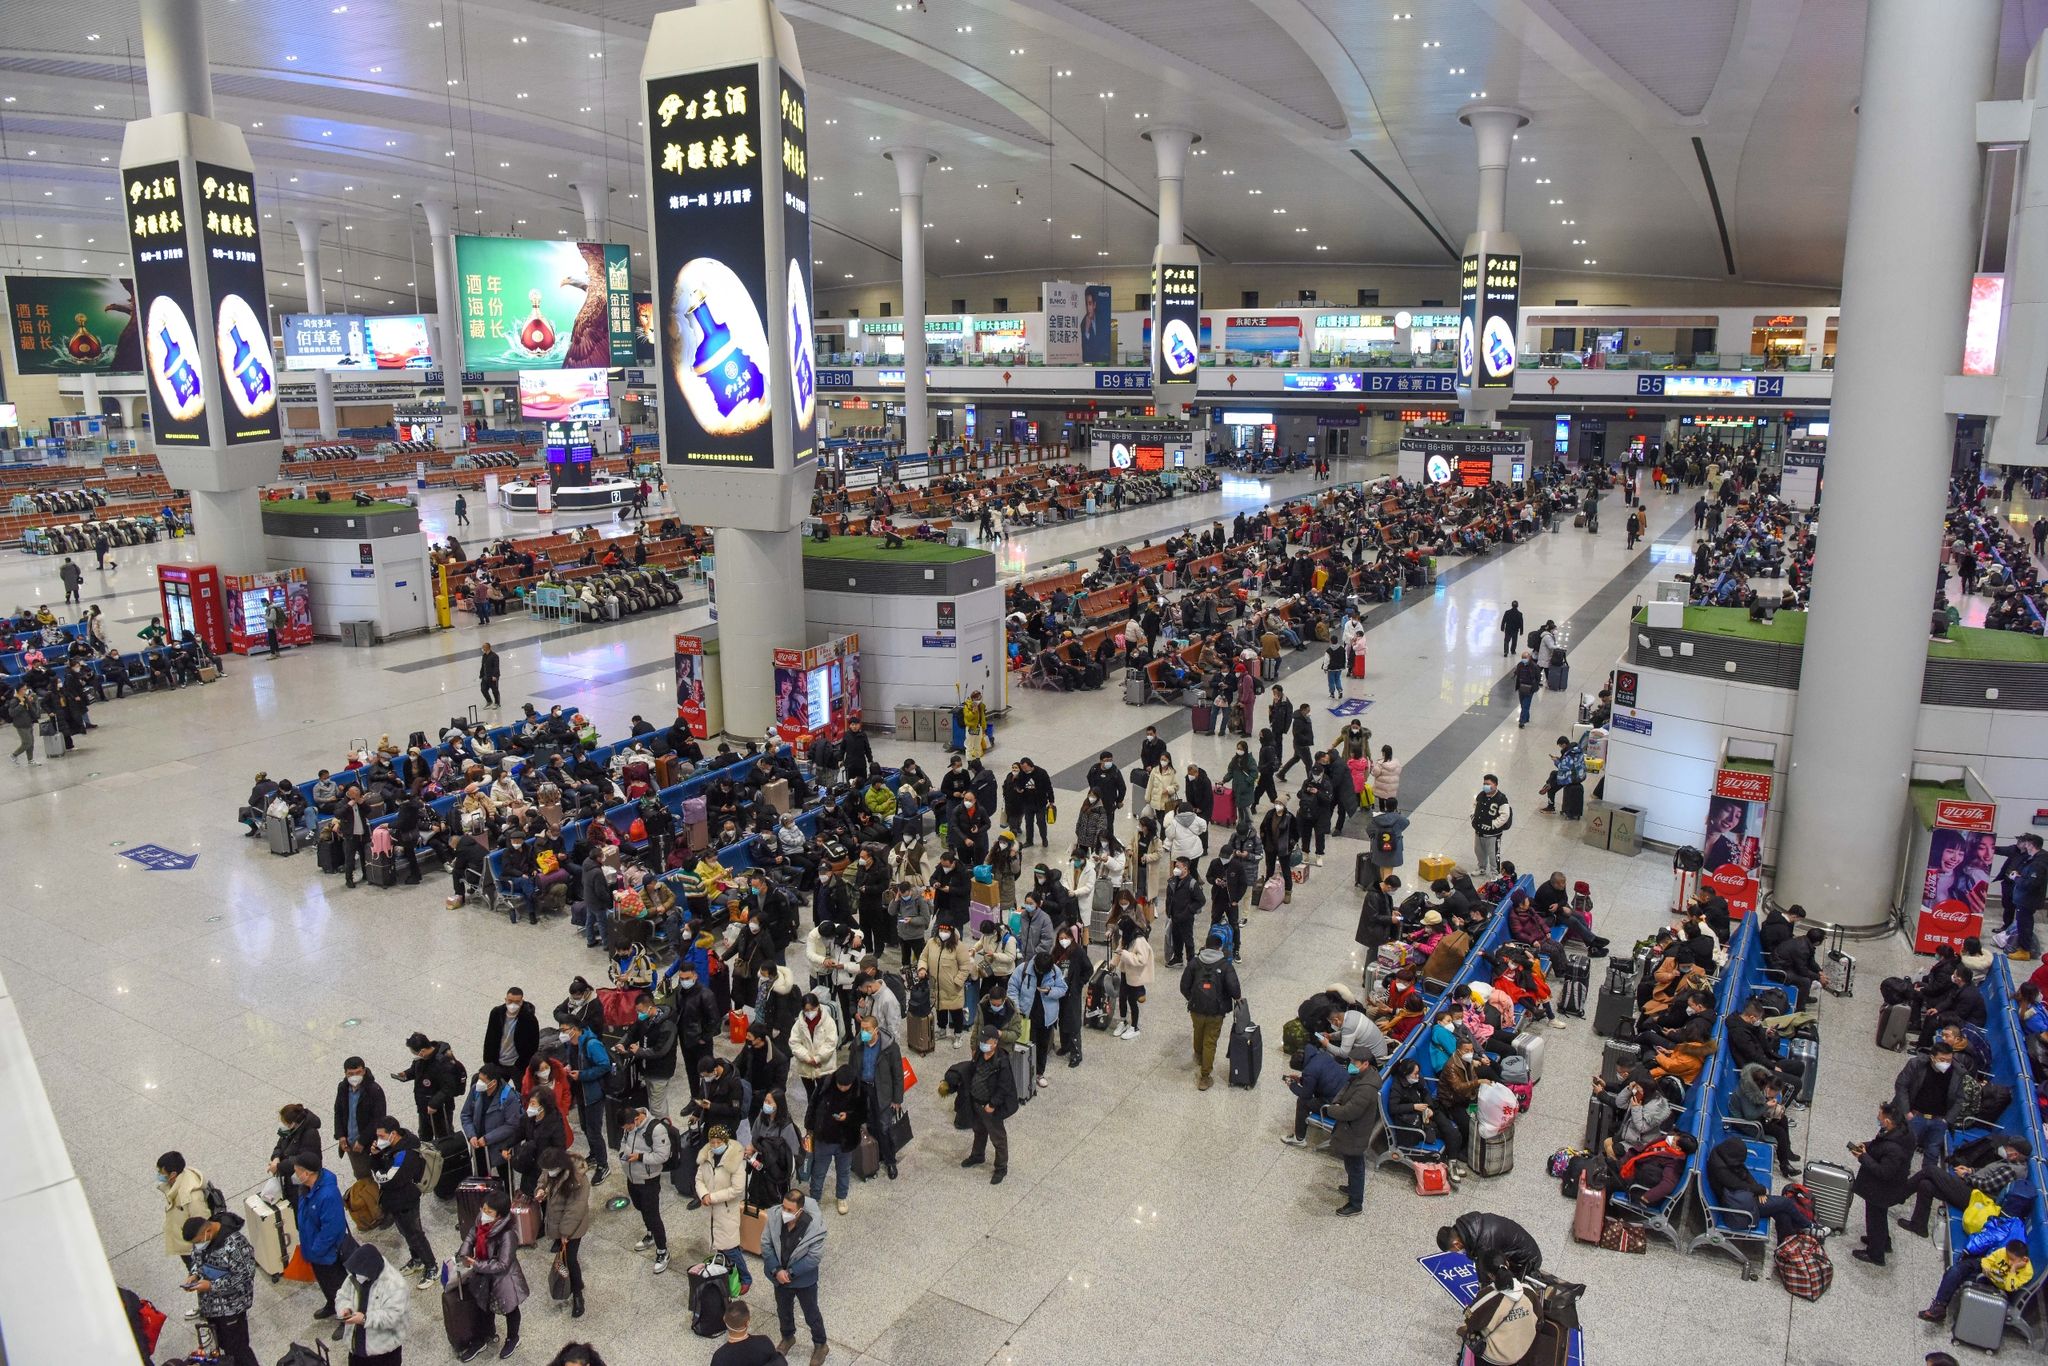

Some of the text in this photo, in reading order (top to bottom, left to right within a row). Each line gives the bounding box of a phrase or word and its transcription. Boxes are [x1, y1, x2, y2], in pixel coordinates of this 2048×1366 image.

[657, 86, 748, 127] 伊力王酒
[661, 133, 756, 175] 新疆荣誉
[130, 177, 176, 204] 伊力王酒
[203, 177, 250, 205] 伊力王酒
[713, 188, 752, 206] 岁月留香
[135, 210, 182, 238] 新疆荣誉
[207, 210, 256, 238] 新疆荣誉
[466, 275, 485, 339] 酒海藏
[487, 275, 505, 338] 年份长
[610, 294, 621, 332] 金徽酒
[620, 294, 631, 332] 正能量
[16, 303, 35, 350] 酒海藏
[35, 304, 53, 349] 年份长
[1049, 314, 1078, 328] 全屋定制
[1235, 317, 1267, 326] 永和大王
[296, 330, 341, 346] 佰草香
[1049, 330, 1078, 343] 现场配齐
[428, 372, 443, 380] B16
[834, 374, 851, 385] B10
[1103, 374, 1120, 387] B9
[1372, 376, 1393, 390] B7
[1398, 379, 1436, 390] 检票口
[1640, 378, 1662, 392] B5
[1757, 379, 1780, 394] B4
[776, 653, 799, 662] 可口可乐
[1723, 777, 1763, 791] 可口可乐
[1488, 803, 1498, 816] S
[1943, 806, 1986, 820] 可口可乐
[1733, 900, 1749, 909] 够爽
[1923, 934, 1965, 945] 这感觉 够
